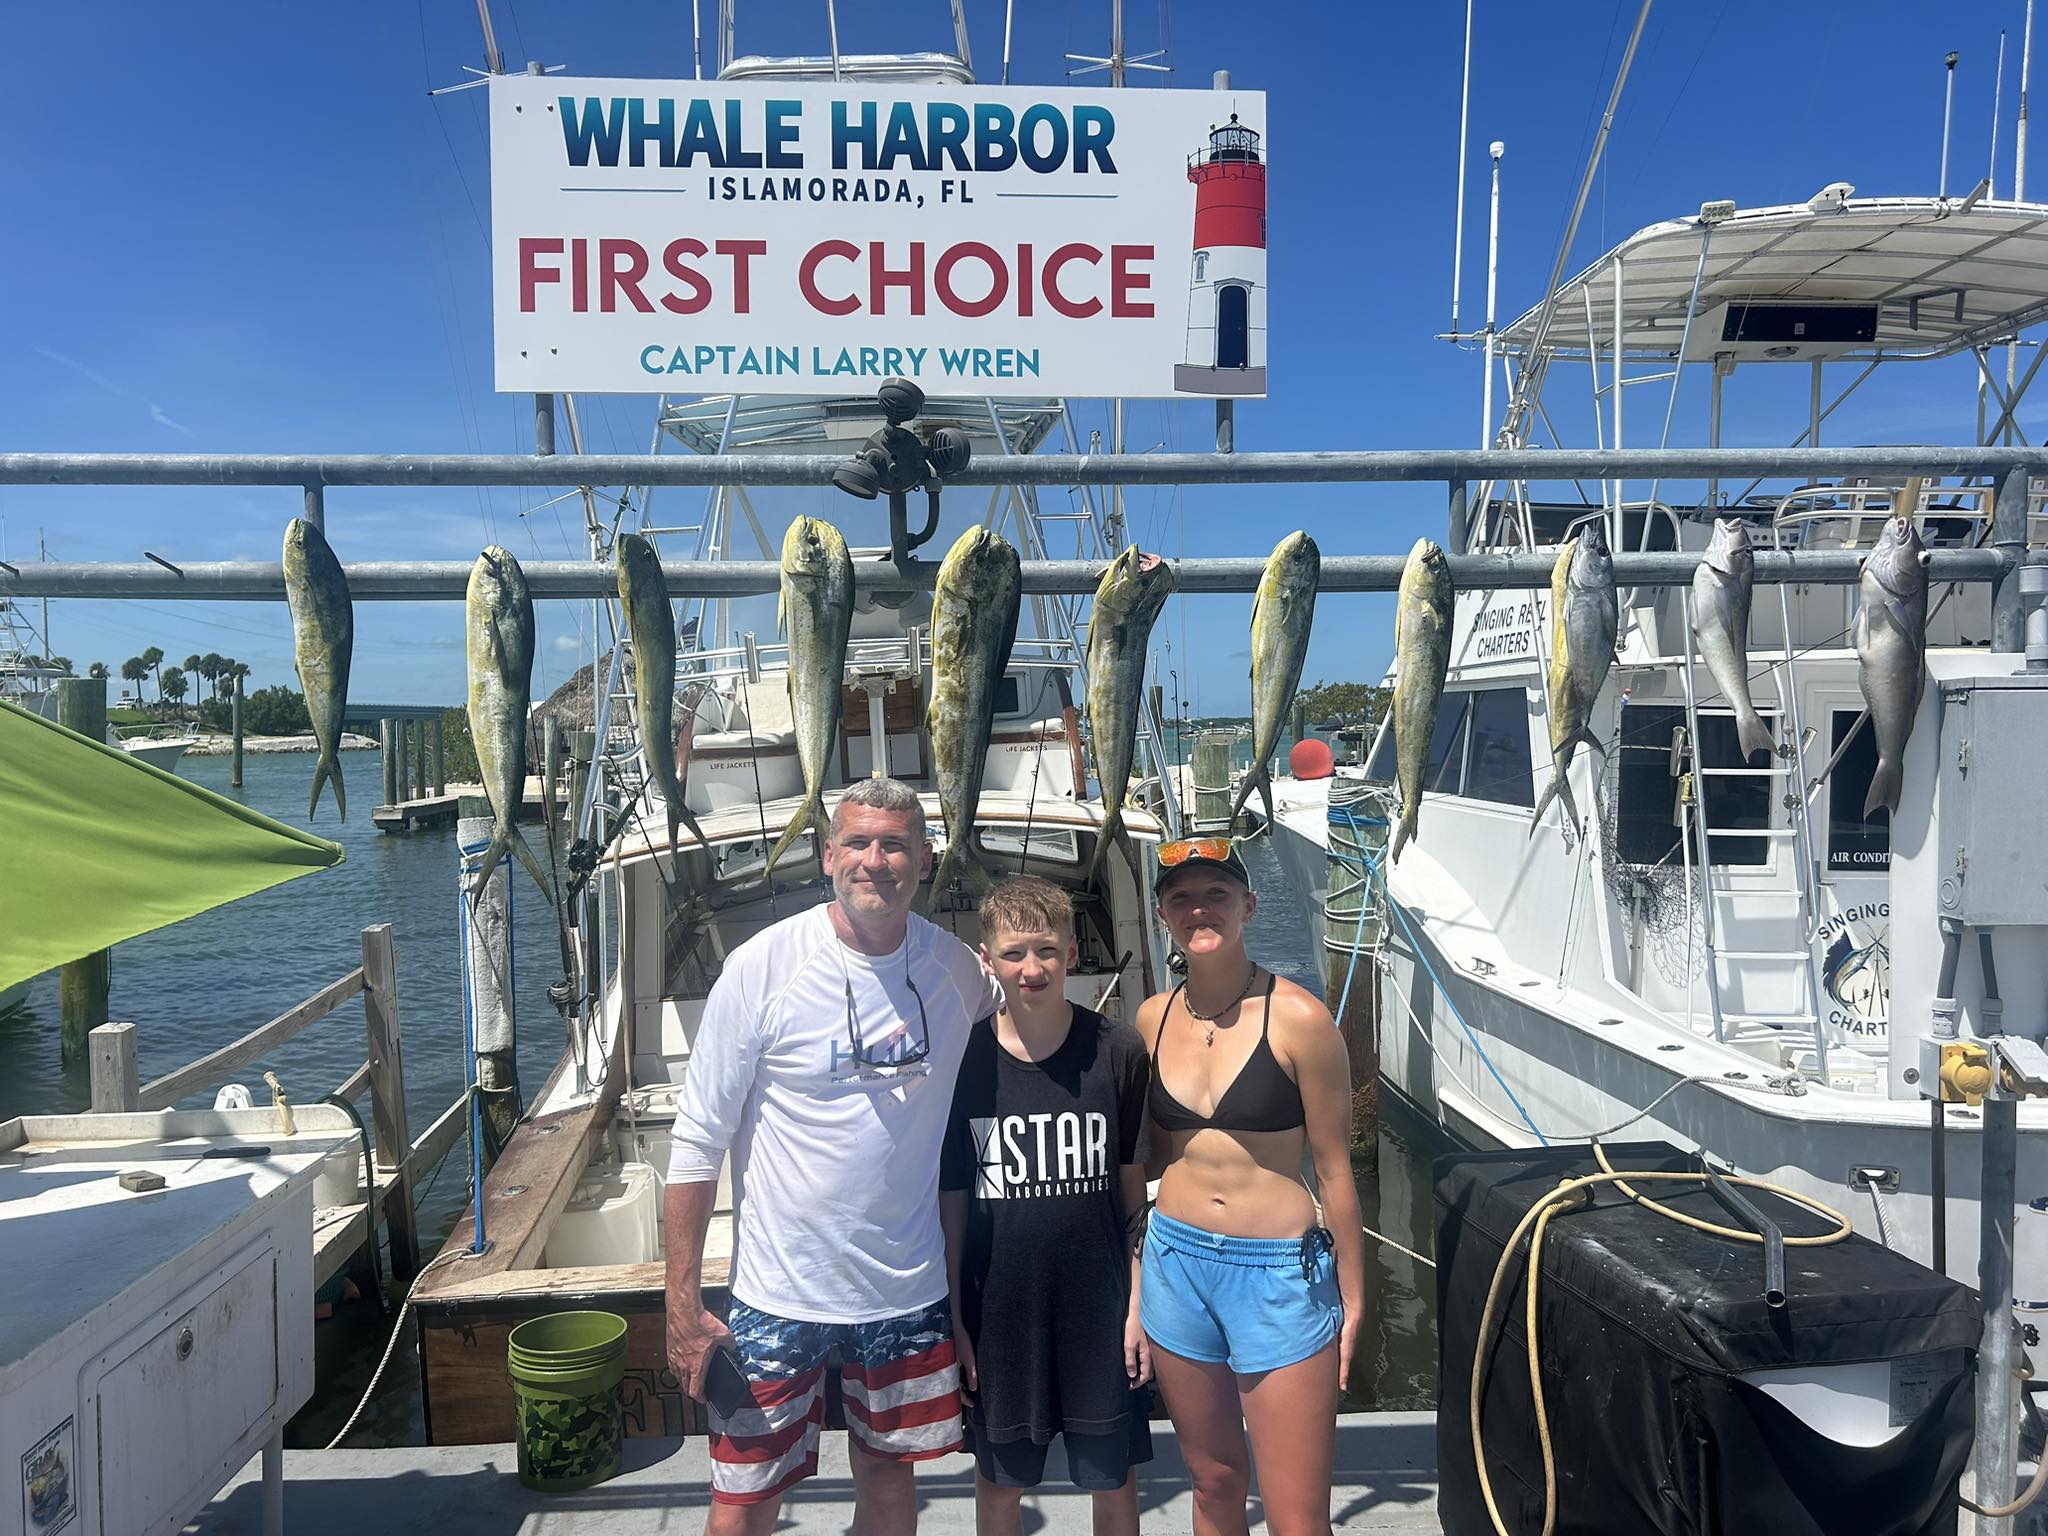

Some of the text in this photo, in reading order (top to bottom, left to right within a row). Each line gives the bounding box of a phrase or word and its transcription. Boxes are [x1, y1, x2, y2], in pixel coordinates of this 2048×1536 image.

[558, 96, 1119, 175] WHALE HARBOR
[708, 176, 974, 209] ISLAMORADA, FL
[518, 237, 1155, 319] FIRST CHOICE
[639, 344, 1040, 378] CAPTAIN LARRY WREN
[1472, 600, 1546, 633] SINGING REL
[1477, 630, 1530, 658] CHARTERS
[1831, 851, 1850, 863] AIR
[1817, 903, 1890, 940] SINGING
[1829, 1010, 1888, 1036] CHART
[1002, 1111, 1109, 1185] S.T.A.R.
[1006, 1177, 1109, 1199] LABORATORIES
